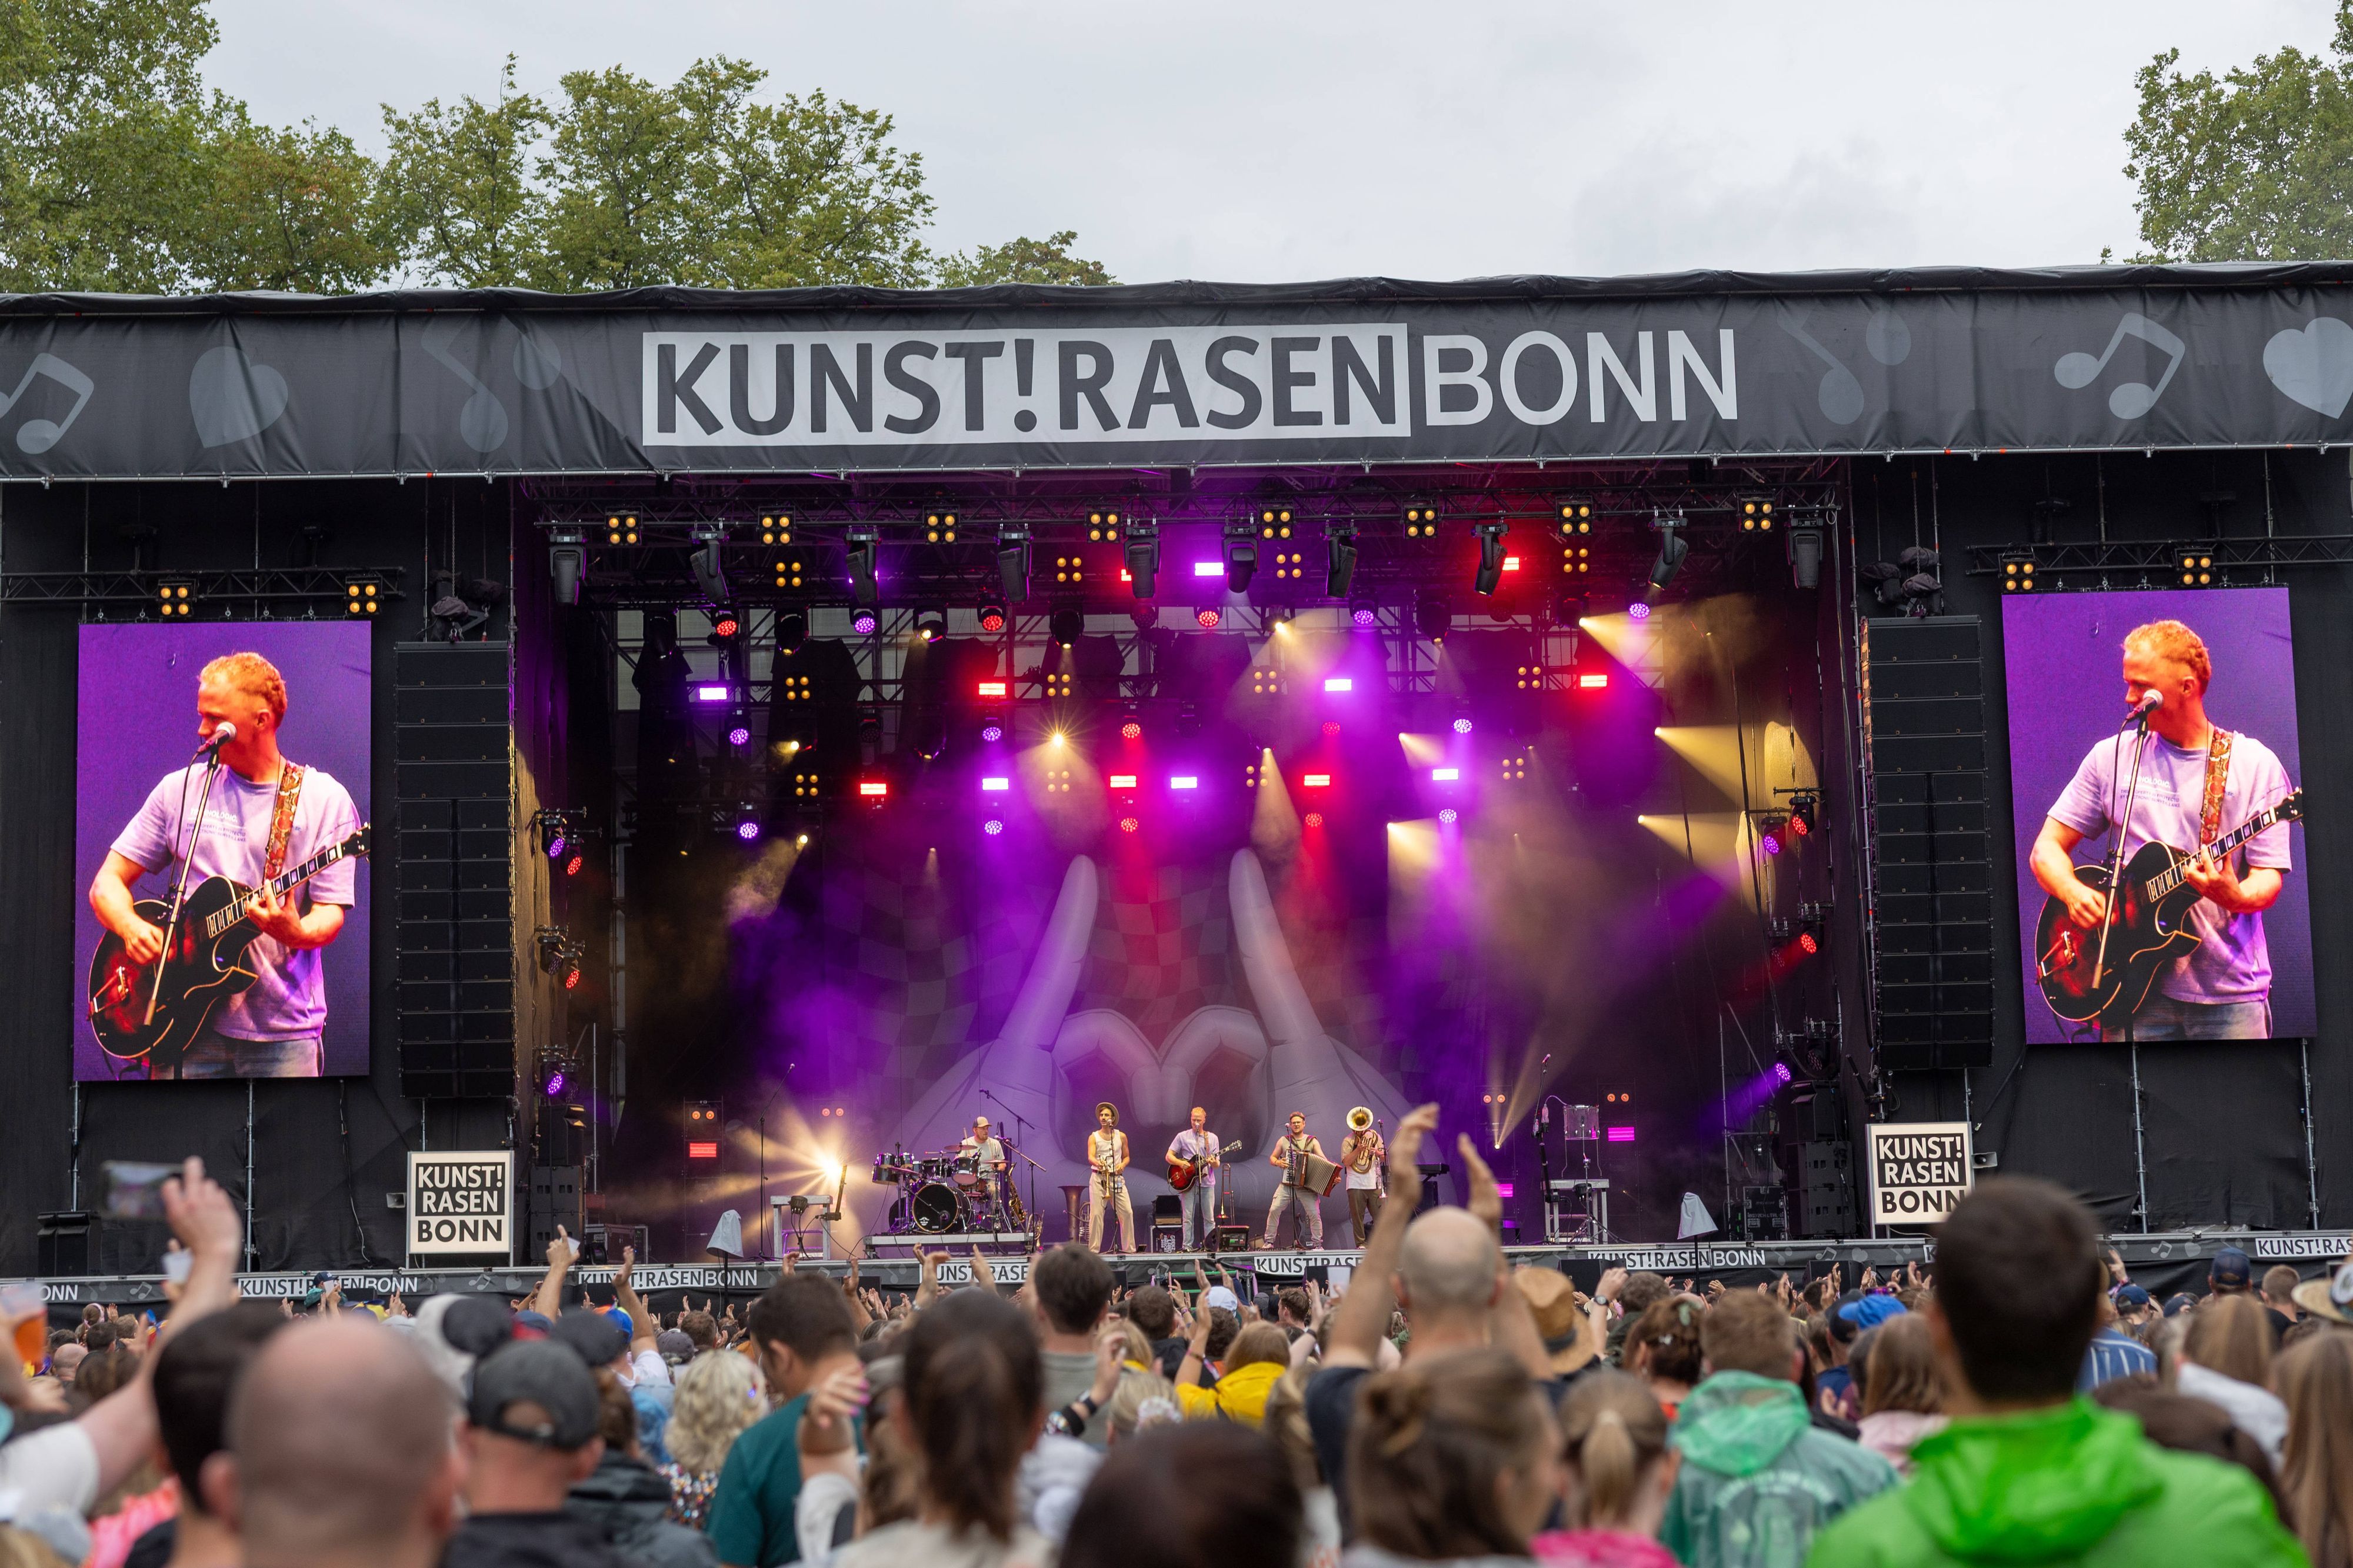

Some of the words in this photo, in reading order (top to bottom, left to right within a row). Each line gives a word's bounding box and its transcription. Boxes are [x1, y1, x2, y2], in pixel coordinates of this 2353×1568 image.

[657, 335, 1395, 435] KUNST!RASEN
[1424, 329, 1738, 426] BONN
[1878, 1136, 1962, 1159] KUNST!
[418, 1165, 503, 1188] KUNST!
[1884, 1161, 1959, 1184] RASEN
[422, 1190, 498, 1213] RASEN
[1881, 1189, 1965, 1213] BONN
[418, 1219, 502, 1242] BONN
[1713, 1250, 1765, 1266] BONN
[365, 1277, 417, 1293] BONN
[581, 1270, 701, 1287] KUNT!RASEN
[705, 1270, 757, 1286] BONN
[39, 1285, 78, 1301] ONN
